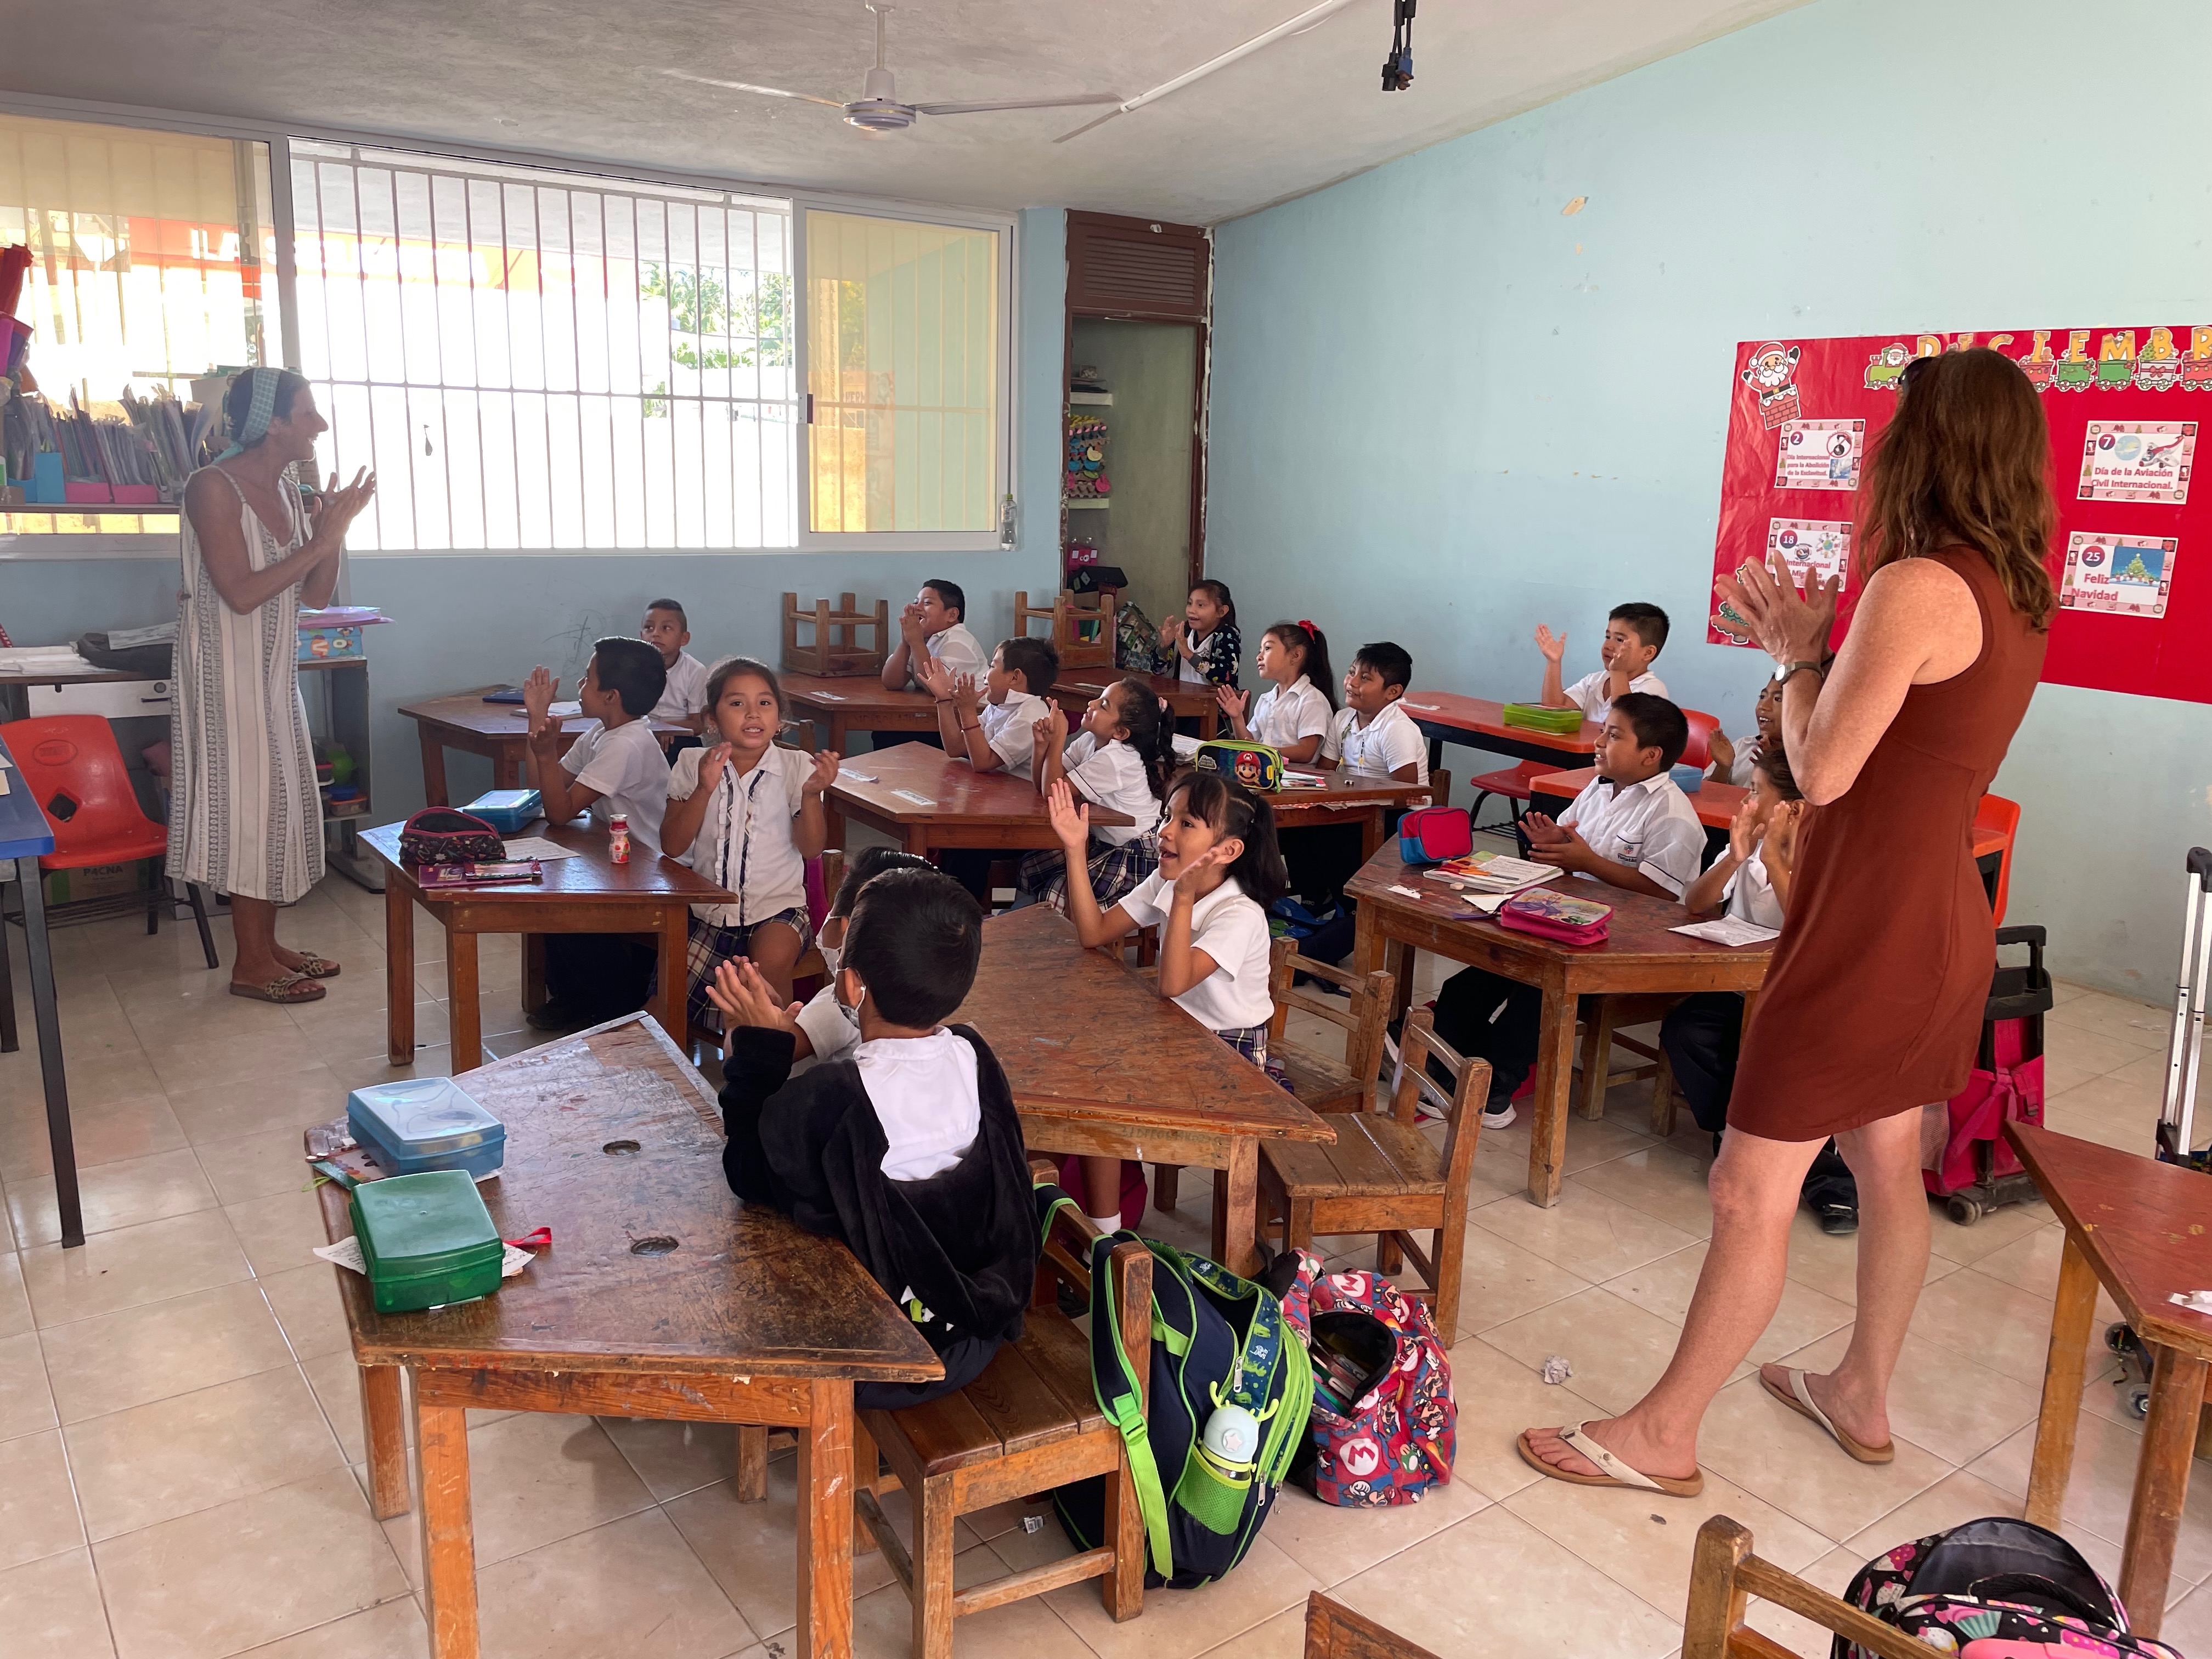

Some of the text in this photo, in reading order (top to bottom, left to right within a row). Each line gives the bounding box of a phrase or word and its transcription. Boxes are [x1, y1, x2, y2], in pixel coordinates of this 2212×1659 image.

[1793, 434, 1800, 444] 2
[2103, 437, 2112, 448] 7
[2095, 467, 2108, 475] Día
[2124, 467, 2132, 476] la
[2134, 468, 2173, 477] Aviación
[2091, 479, 2173, 489] Civil Internacional.
[1783, 535, 1795, 544] 18
[2086, 551, 2101, 562] 25
[2084, 573, 2110, 584] Feliz
[2071, 588, 2119, 601] Navidad
